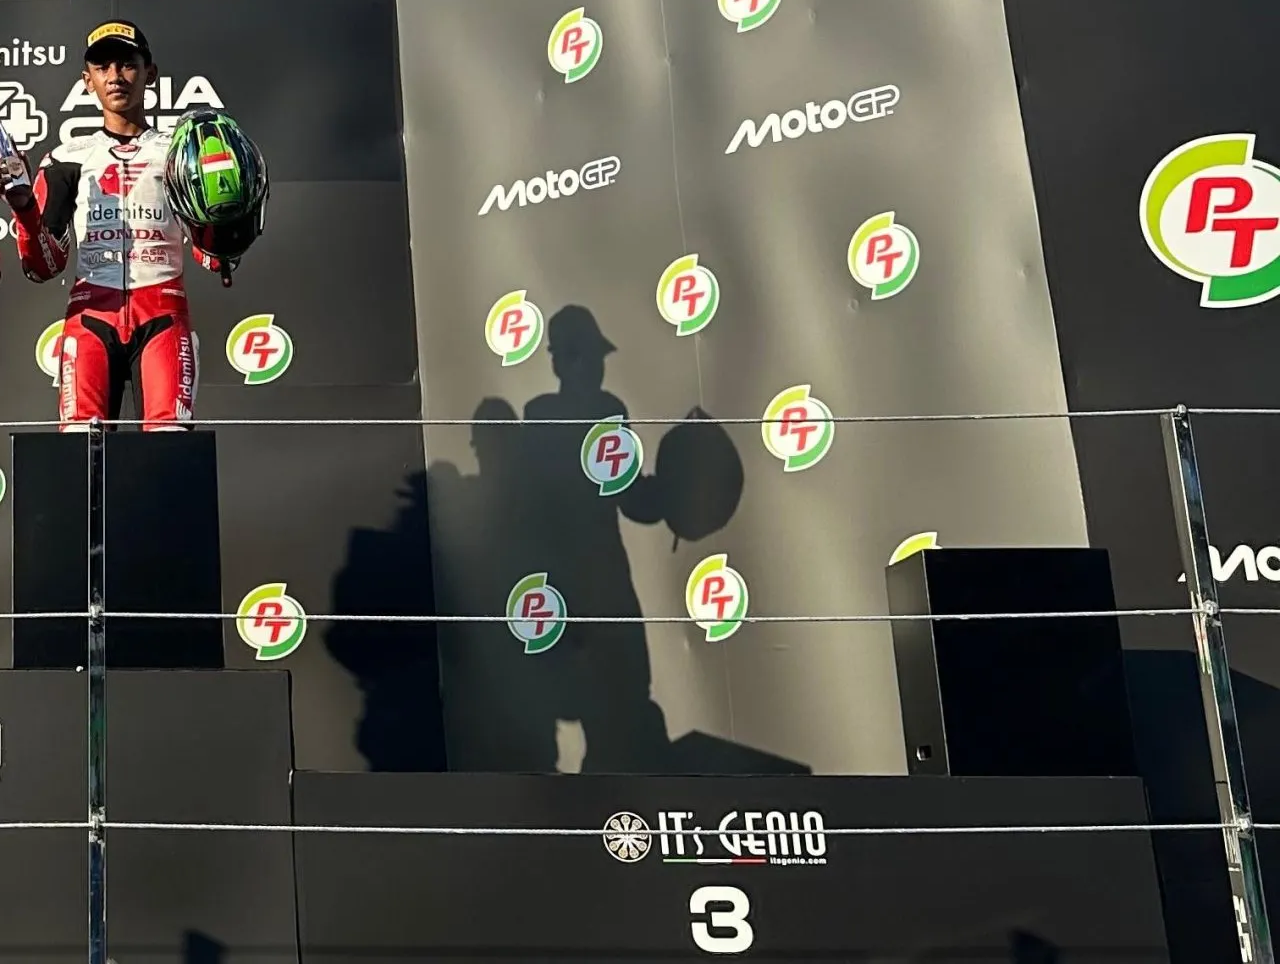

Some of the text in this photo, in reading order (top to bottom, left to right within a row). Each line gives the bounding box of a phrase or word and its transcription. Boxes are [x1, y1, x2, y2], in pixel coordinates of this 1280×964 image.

[561, 27, 590, 64] PT
[725, 84, 900, 154] MotoGP
[478, 156, 621, 216] MotoGP
[87, 227, 166, 243] HONDA
[1185, 176, 1280, 268] PT
[865, 233, 902, 278] PT
[672, 274, 705, 317] PT
[242, 330, 280, 369] PT
[500, 309, 529, 349] PT
[178, 337, 192, 401] idemitsu
[779, 406, 817, 452] PT
[598, 435, 628, 475] PT
[523, 593, 553, 634] PT
[701, 575, 734, 621] PT
[253, 601, 293, 644] PT
[719, 811, 827, 856] GENIO
[770, 856, 828, 866] itsgenio.com
[689, 886, 754, 953] 3
